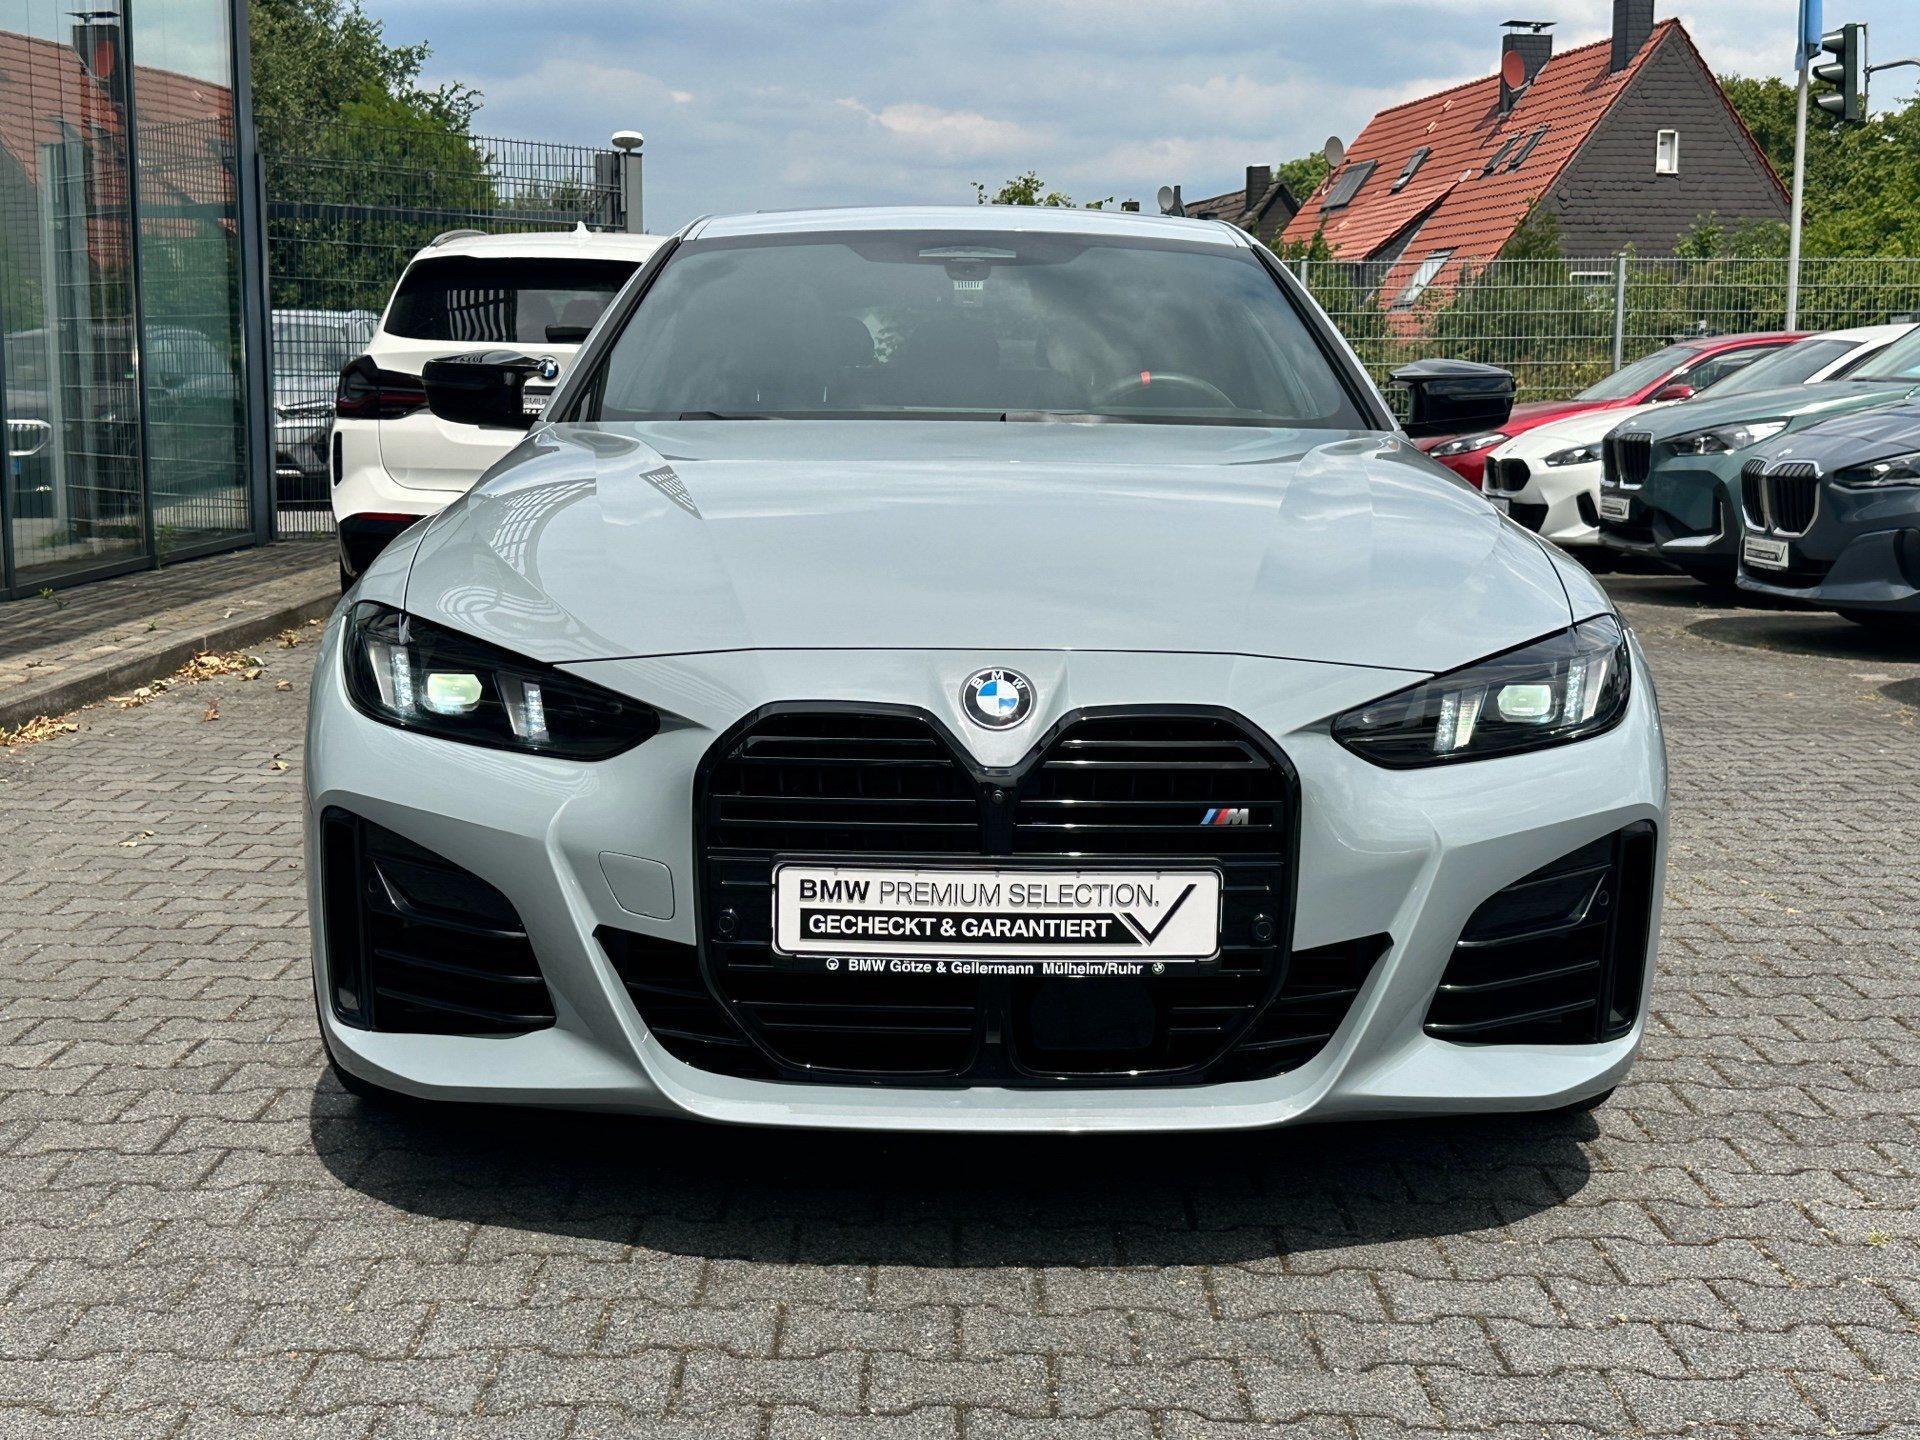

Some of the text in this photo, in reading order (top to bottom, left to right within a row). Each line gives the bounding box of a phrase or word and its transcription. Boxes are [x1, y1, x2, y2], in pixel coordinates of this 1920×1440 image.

[971, 669, 1026, 689] BMW
[800, 879, 1159, 907] BMW PREMIUM SELECTION.
[808, 914, 1112, 938] GECHECKT & GARANTIERT
[848, 959, 1143, 976] BMW Götze & Gellermann Mülheim/Ruhr
